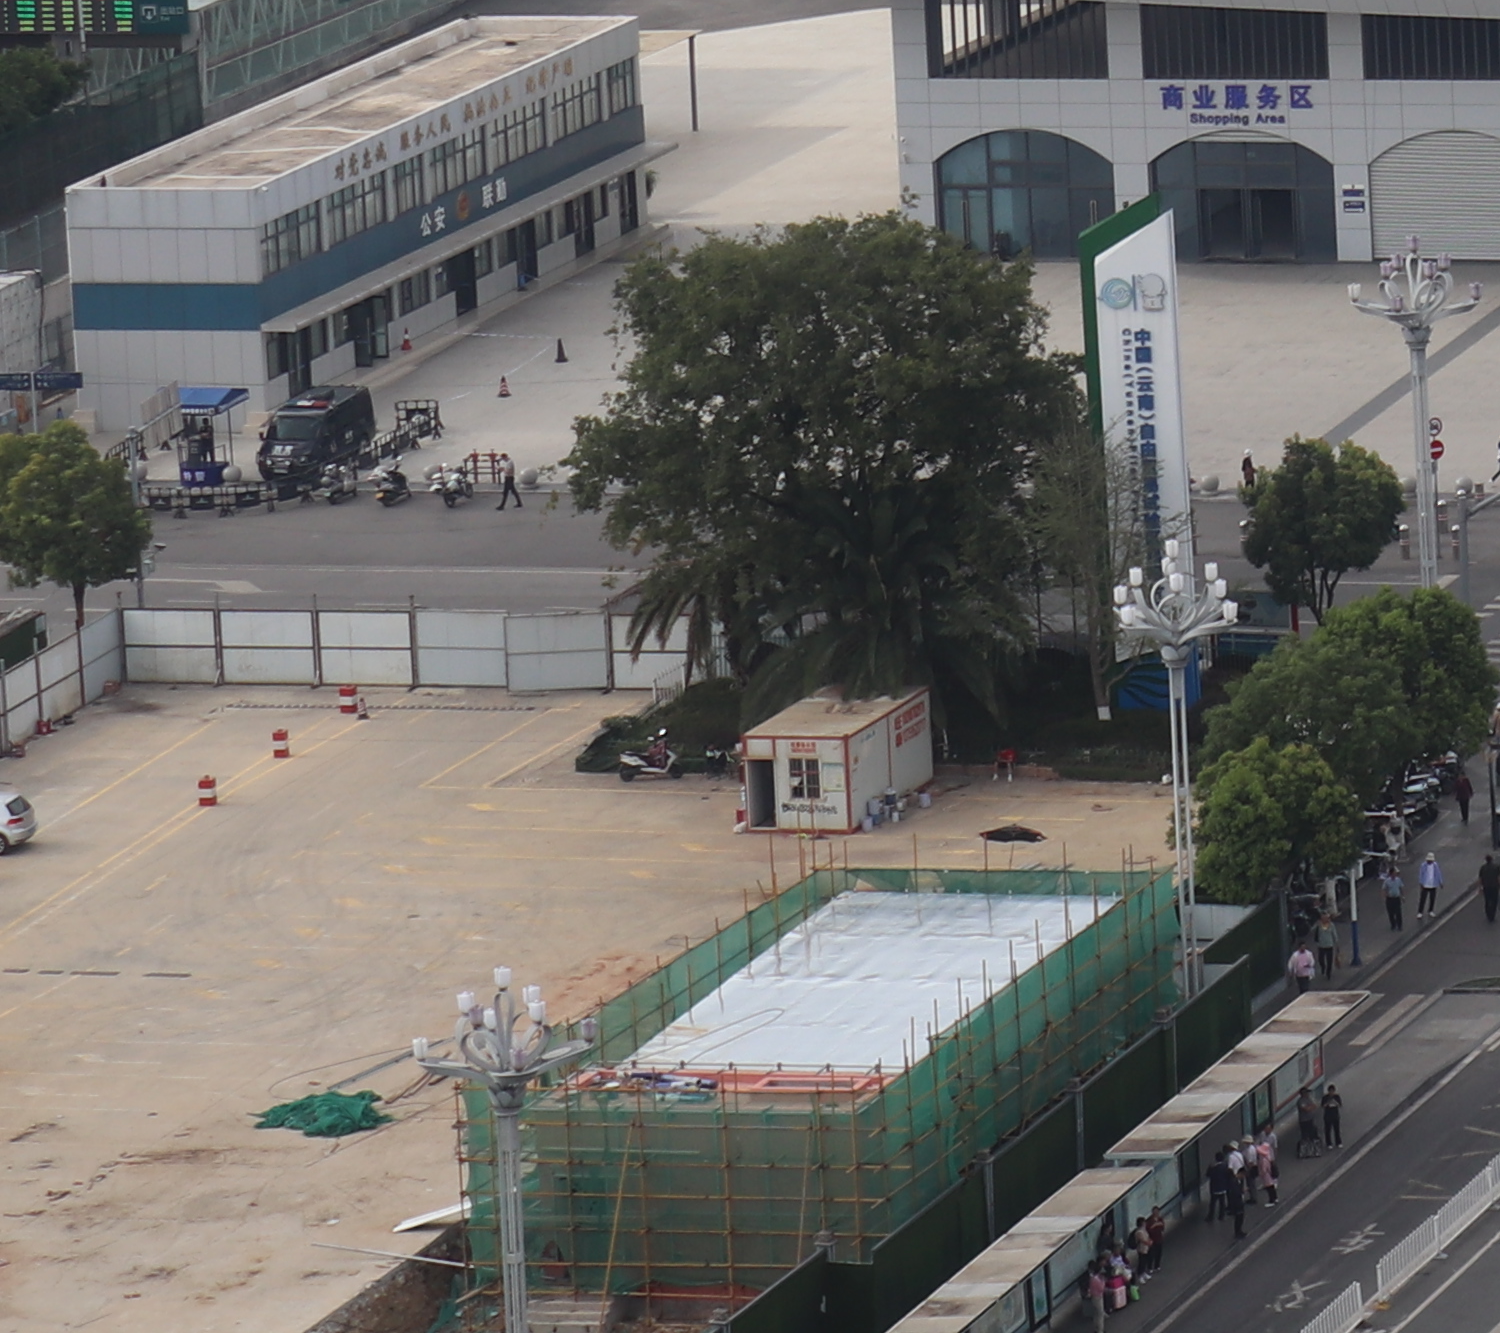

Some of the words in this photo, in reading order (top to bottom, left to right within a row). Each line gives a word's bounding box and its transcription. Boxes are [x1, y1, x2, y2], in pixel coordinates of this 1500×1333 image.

[1160, 83, 1314, 110] 商业服务区
[1189, 113, 1250, 126] Shopping
[1255, 113, 1286, 124] Area
[419, 205, 447, 237] 公安
